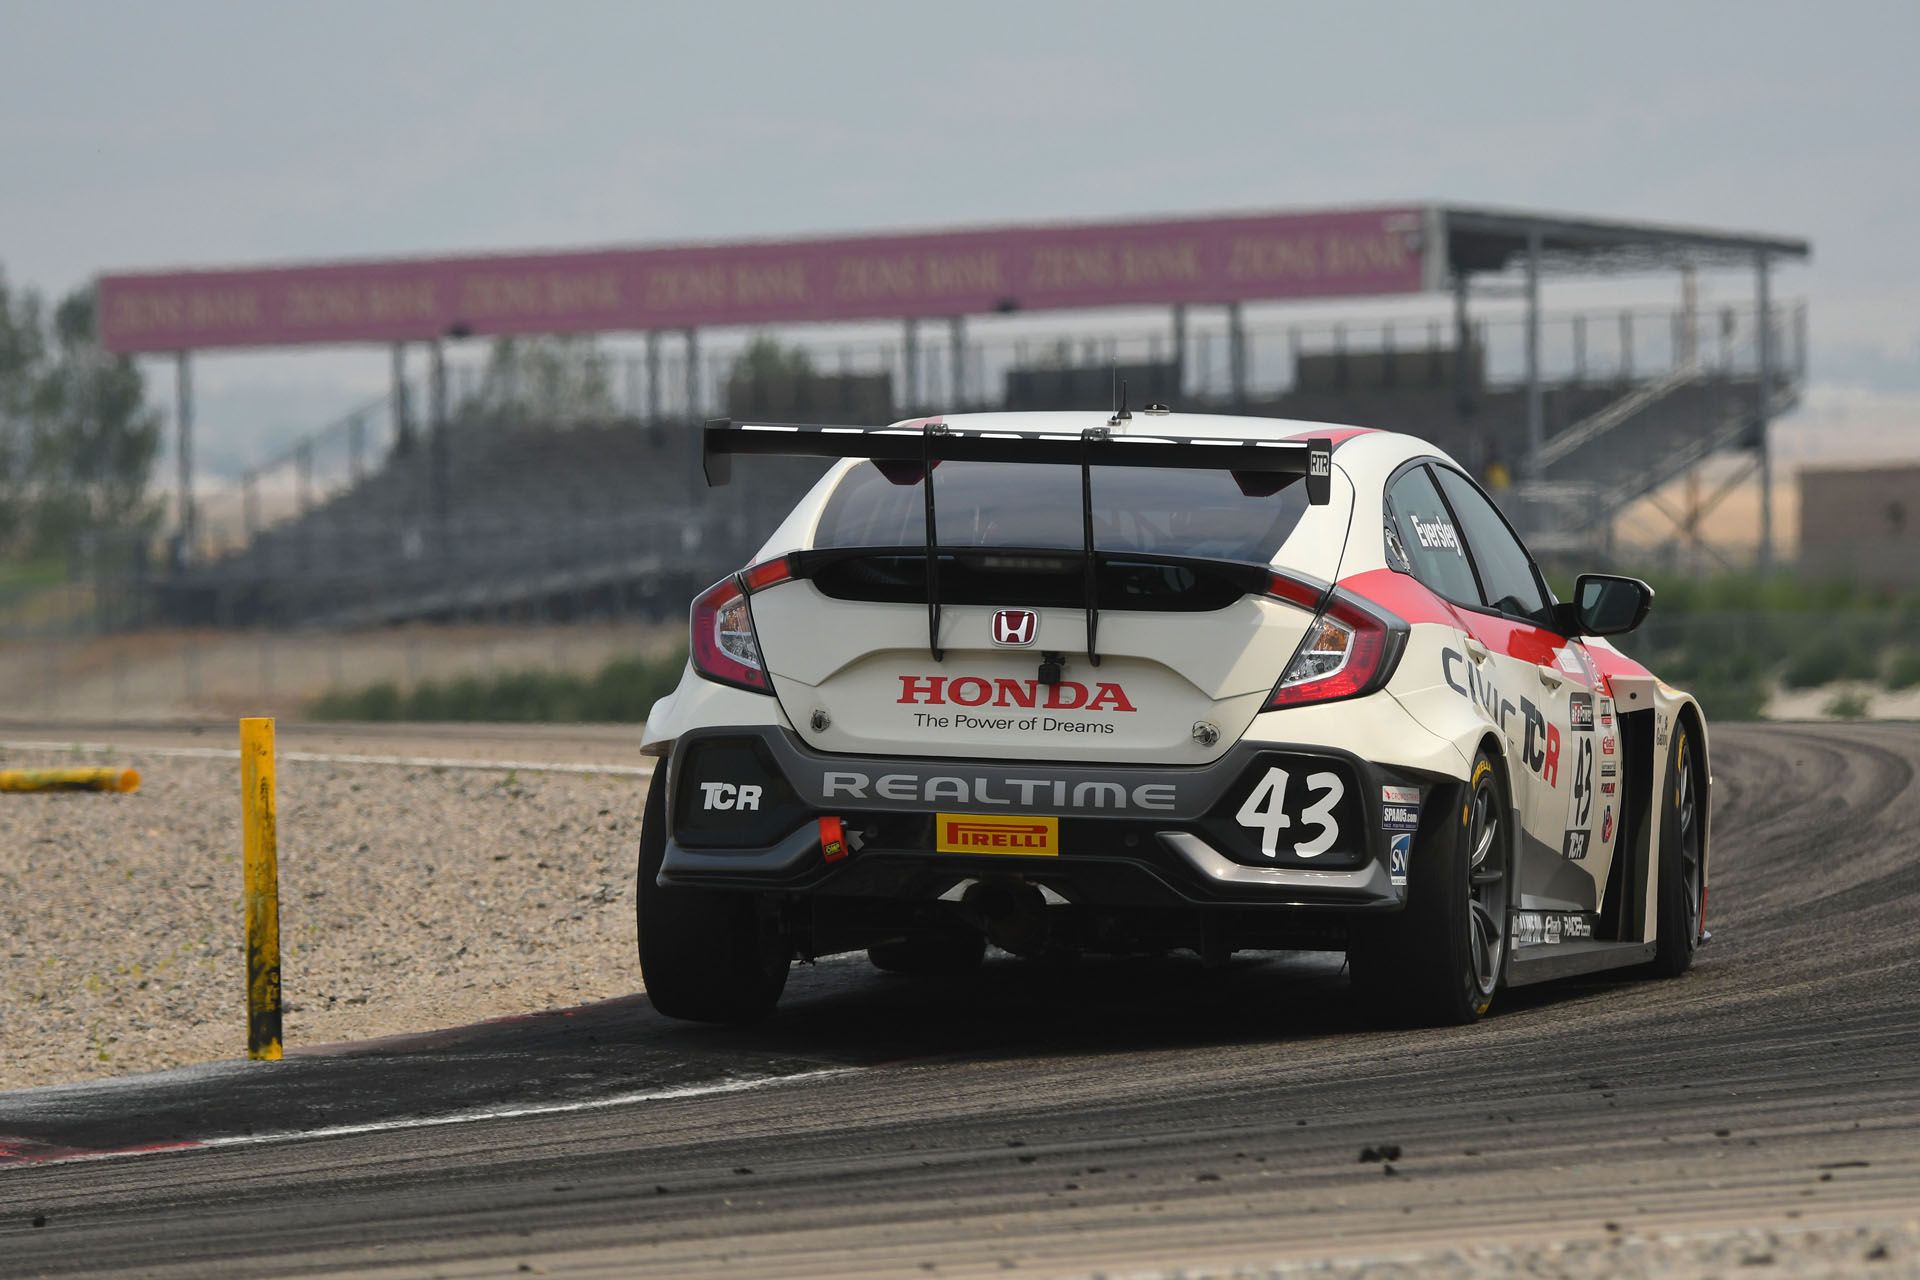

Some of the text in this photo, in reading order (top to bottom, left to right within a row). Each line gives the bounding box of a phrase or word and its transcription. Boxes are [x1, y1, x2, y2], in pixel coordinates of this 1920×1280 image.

[1312, 454, 1329, 473] RTR
[1410, 514, 1462, 557] Eversley
[897, 676, 1138, 713] HONDA
[914, 713, 1116, 735] The Power of Dreams
[1442, 647, 1517, 733] CIVIC
[1520, 695, 1560, 789] TCR
[700, 781, 763, 812] TCR
[823, 771, 1177, 811] REALTIME
[1574, 736, 1592, 827] 43
[1236, 767, 1345, 859] 43
[947, 821, 1048, 849] PIRELLI
[1568, 832, 1585, 859] TCR
[1392, 848, 1408, 872] SN
